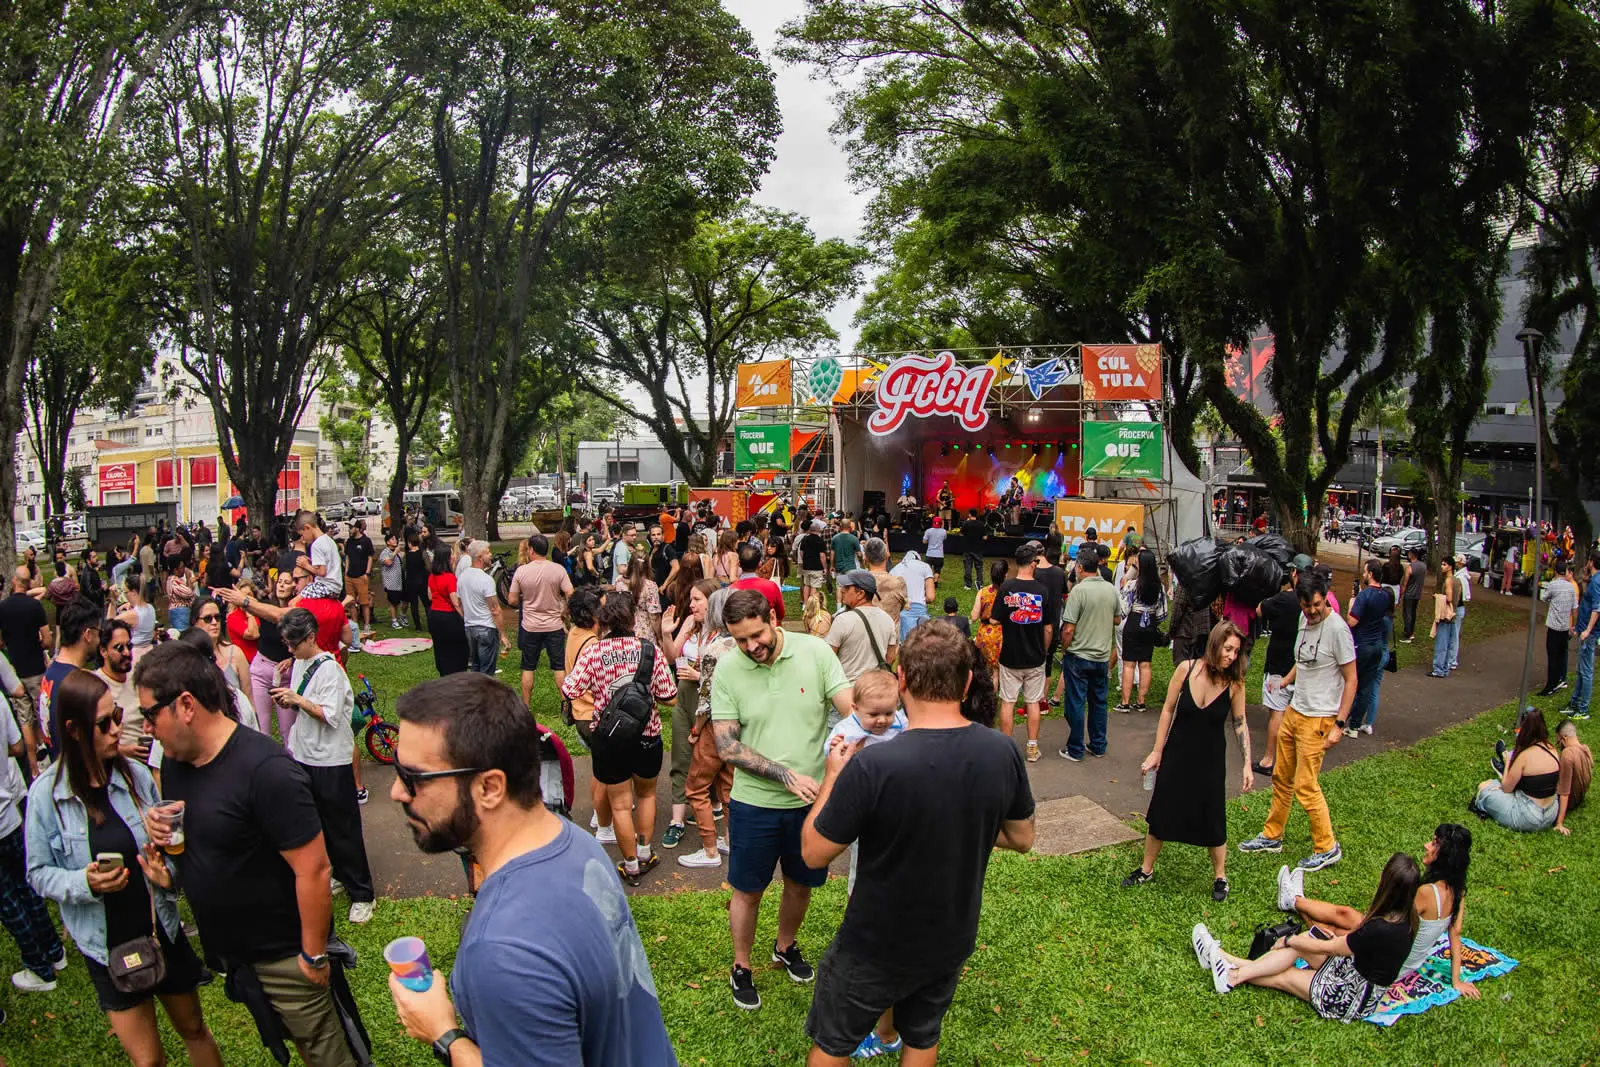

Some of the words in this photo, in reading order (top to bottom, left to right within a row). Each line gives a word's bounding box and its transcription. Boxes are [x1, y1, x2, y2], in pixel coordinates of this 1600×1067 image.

[1097, 356, 1129, 370] CUL
[1099, 373, 1146, 387] TURA
[1119, 430, 1154, 440] PROCERVA
[749, 442, 775, 454] QUE
[1105, 443, 1140, 457] QUE
[1061, 515, 1126, 534] TRANS
